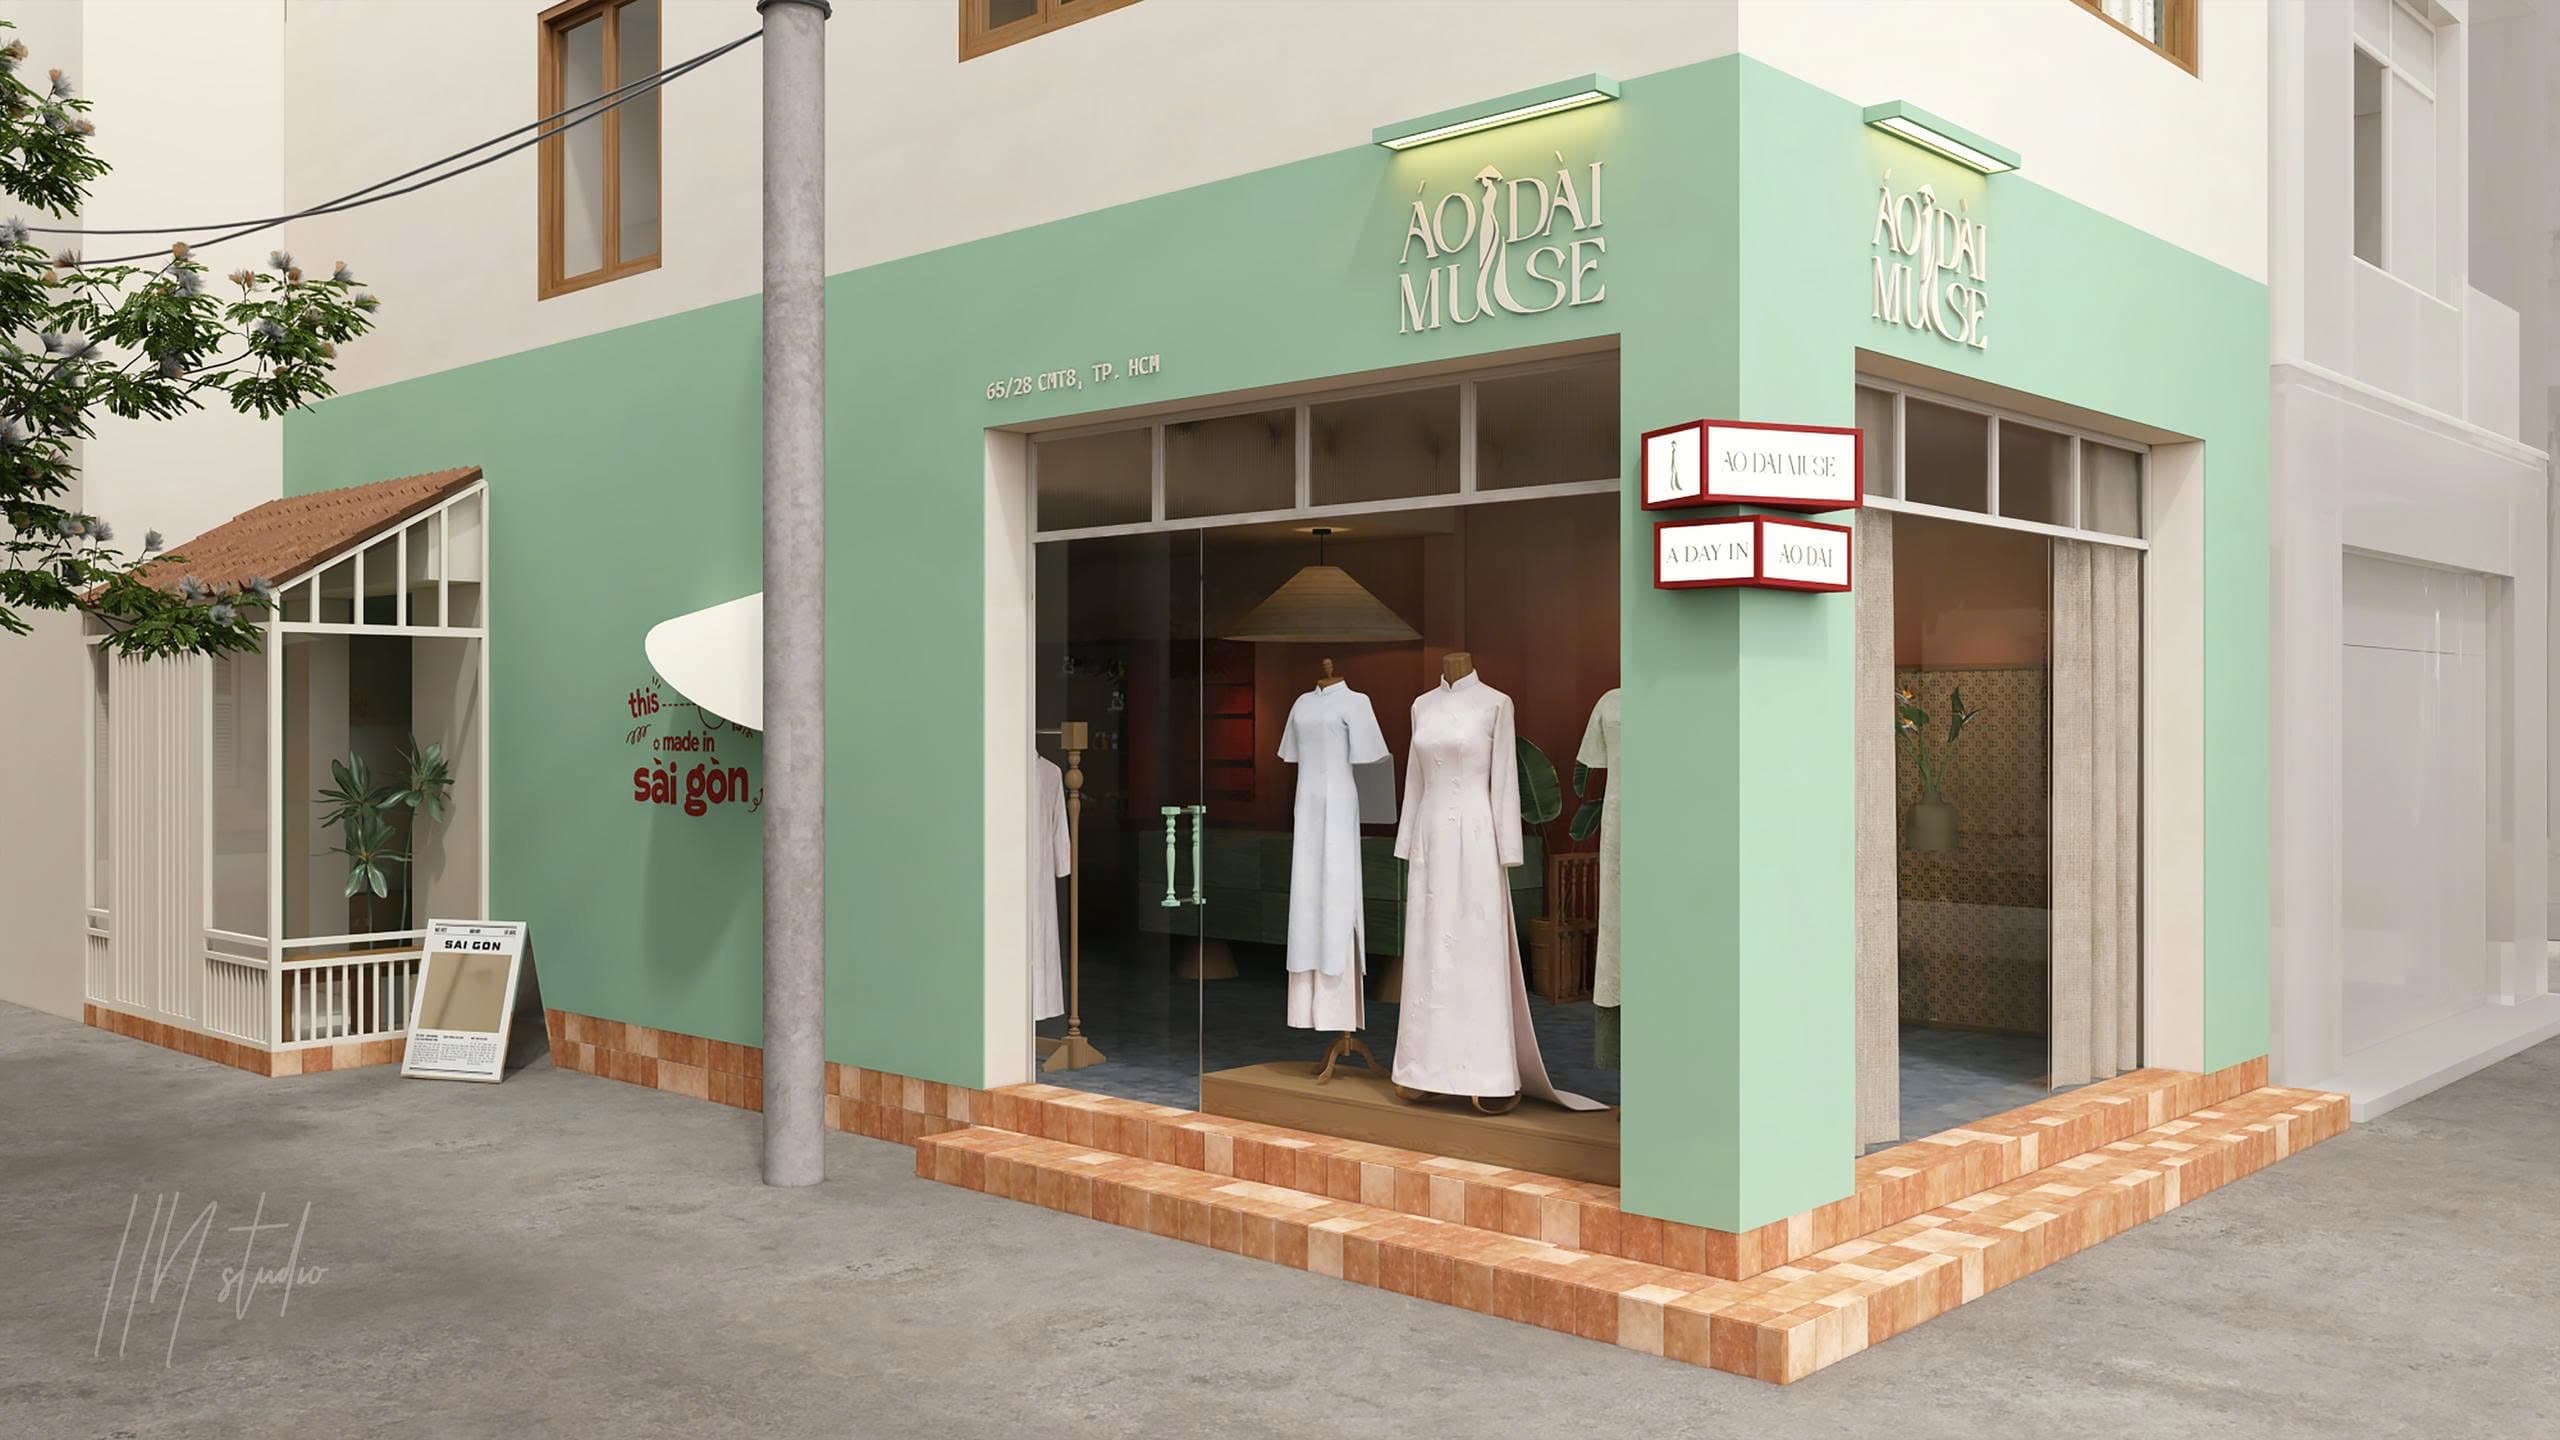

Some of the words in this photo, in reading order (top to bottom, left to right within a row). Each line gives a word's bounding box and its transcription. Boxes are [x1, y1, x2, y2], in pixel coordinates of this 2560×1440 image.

[1506, 150, 1604, 243] DÀI
[1400, 236, 1606, 333] MUSE
[1871, 256, 1988, 350] MUSE
[986, 375, 1033, 400] 65/28
[1038, 368, 1083, 391] CMT8,
[1092, 362, 1120, 383] TP.
[1128, 353, 1161, 377] HCM
[1666, 547, 1679, 564] A
[1685, 543, 1722, 563] DAY
[1729, 542, 1749, 561] IN
[628, 687, 660, 719] this
[662, 730, 700, 752] made
[703, 731, 716, 752] in
[633, 757, 678, 805] sài
[684, 756, 750, 817] gòn
[444, 939, 468, 950] SAI
[471, 941, 502, 951] GON
